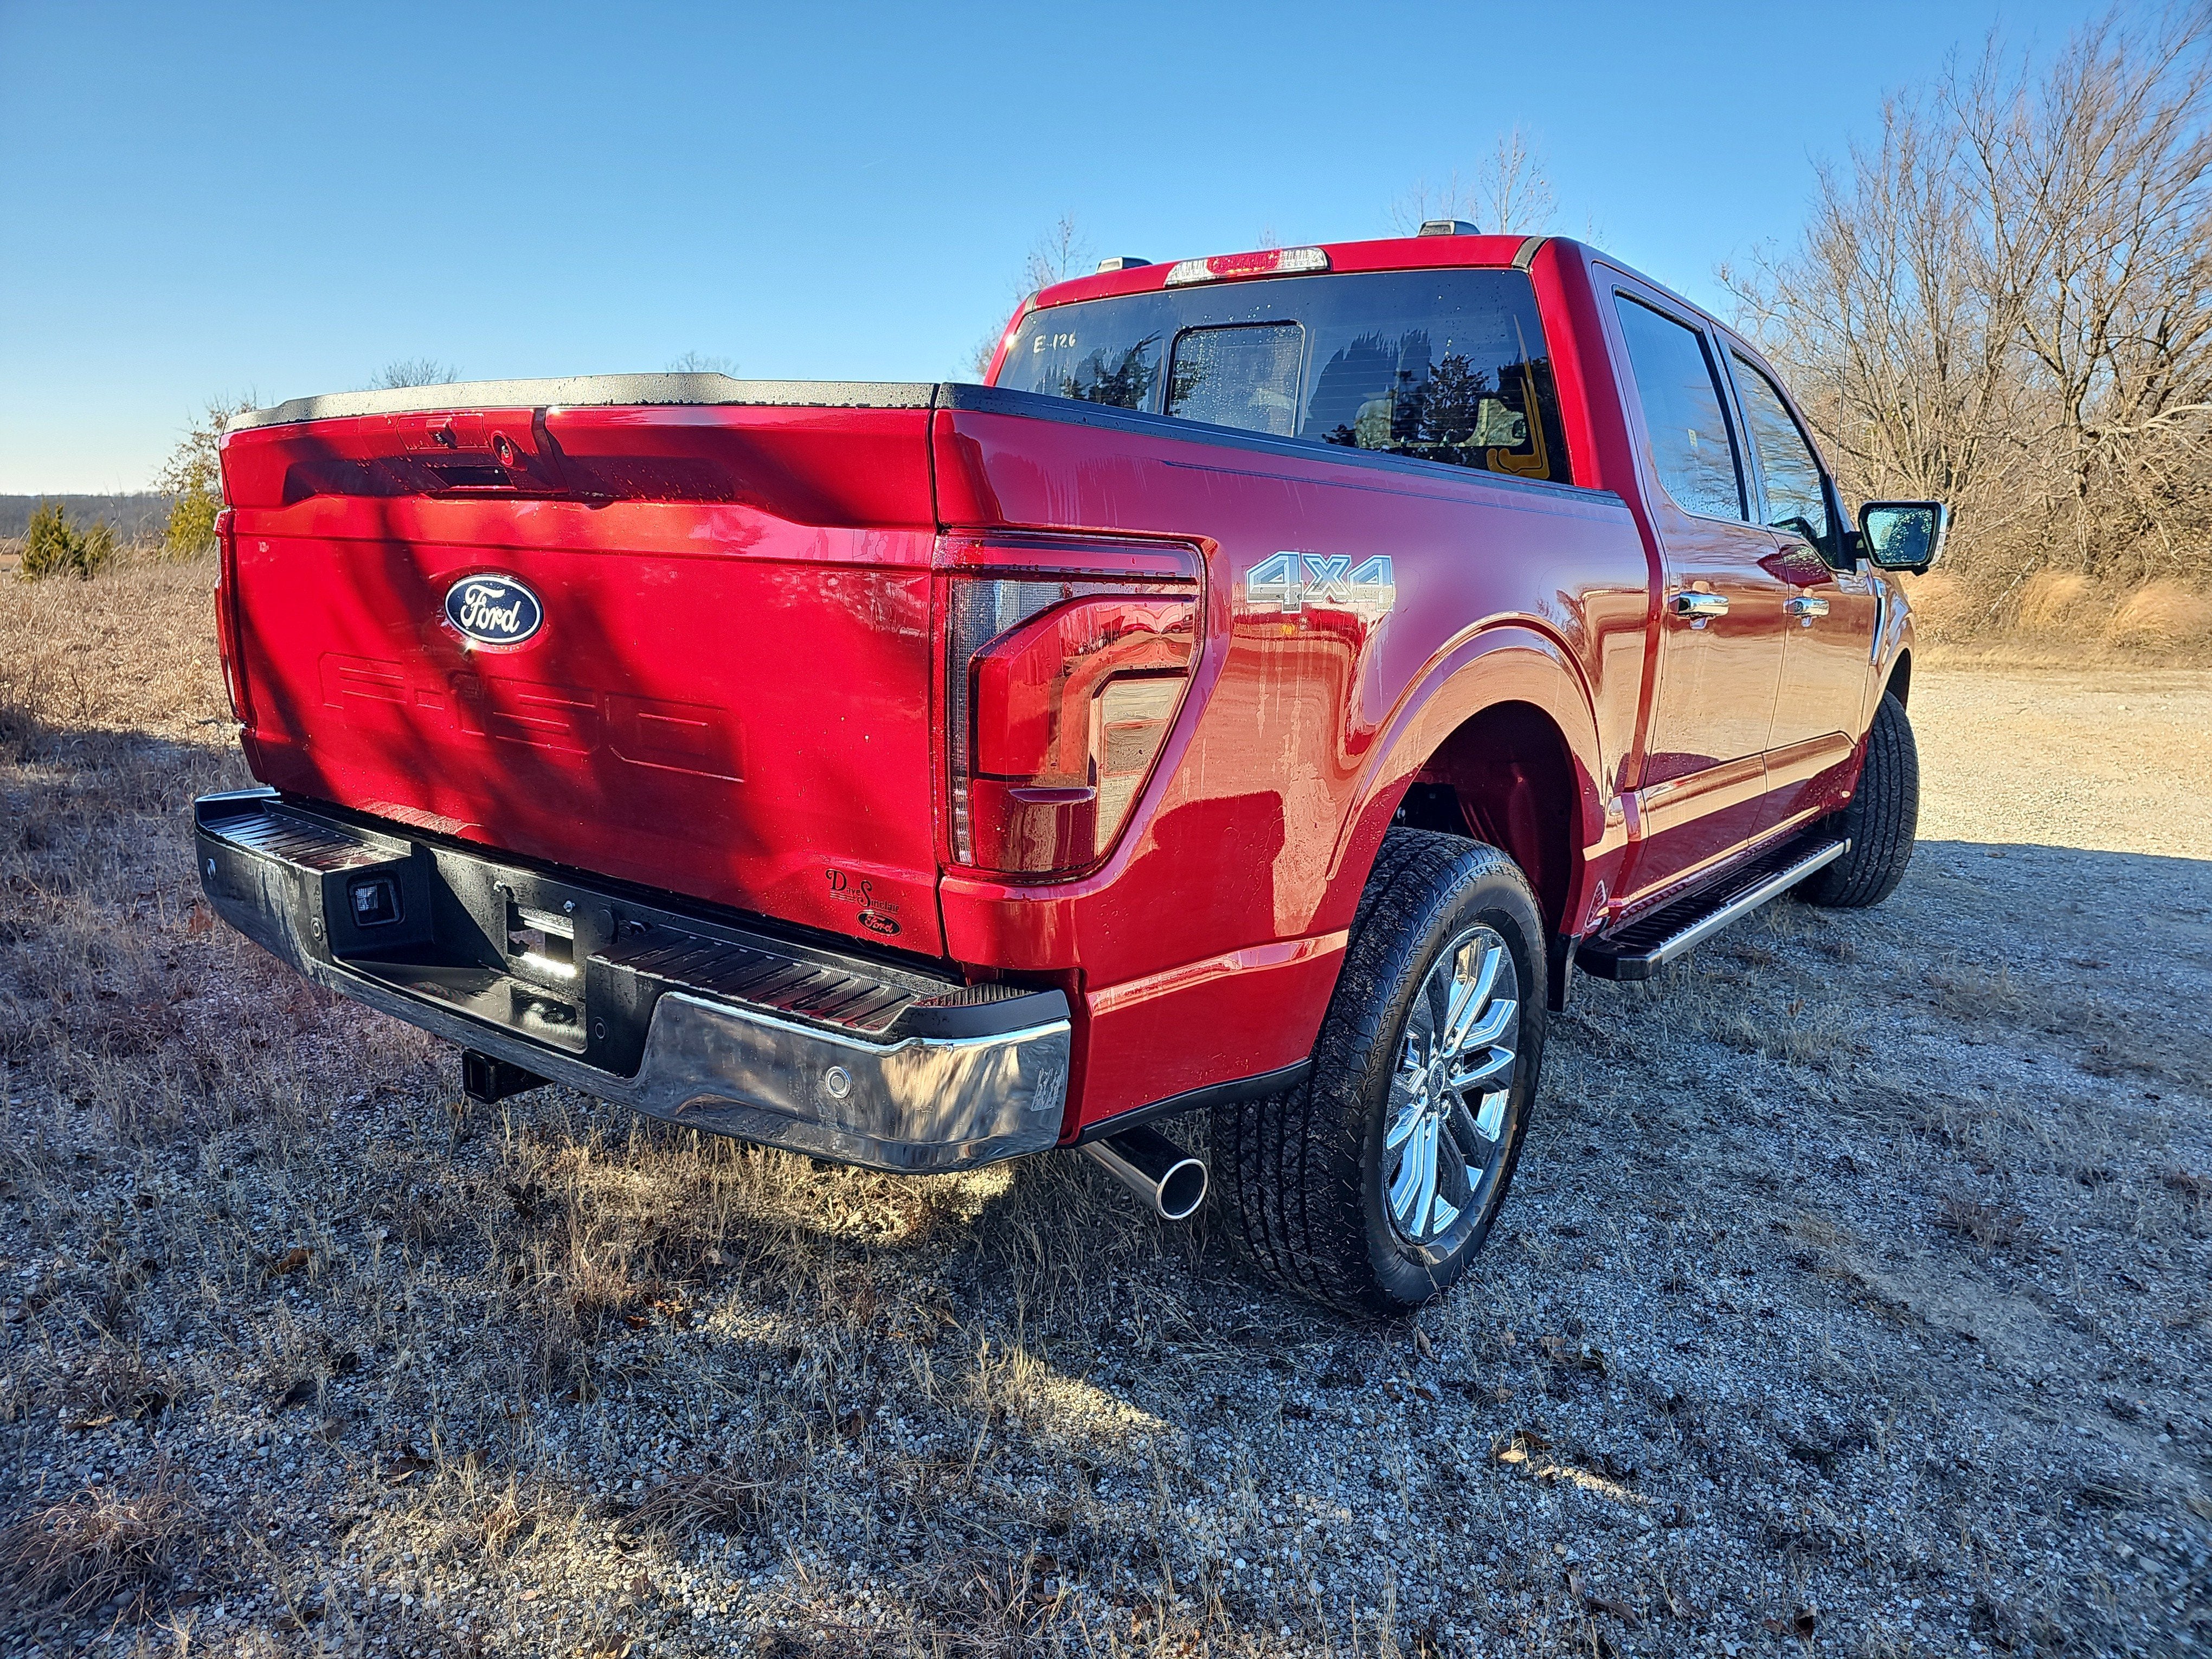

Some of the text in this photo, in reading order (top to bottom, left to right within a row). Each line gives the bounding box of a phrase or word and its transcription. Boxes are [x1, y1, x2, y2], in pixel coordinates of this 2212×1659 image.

[460, 584, 521, 633] Ford
[318, 652, 746, 782] F-150
[826, 869, 899, 914] Dave Sinclair
[865, 915, 893, 933] Ford
